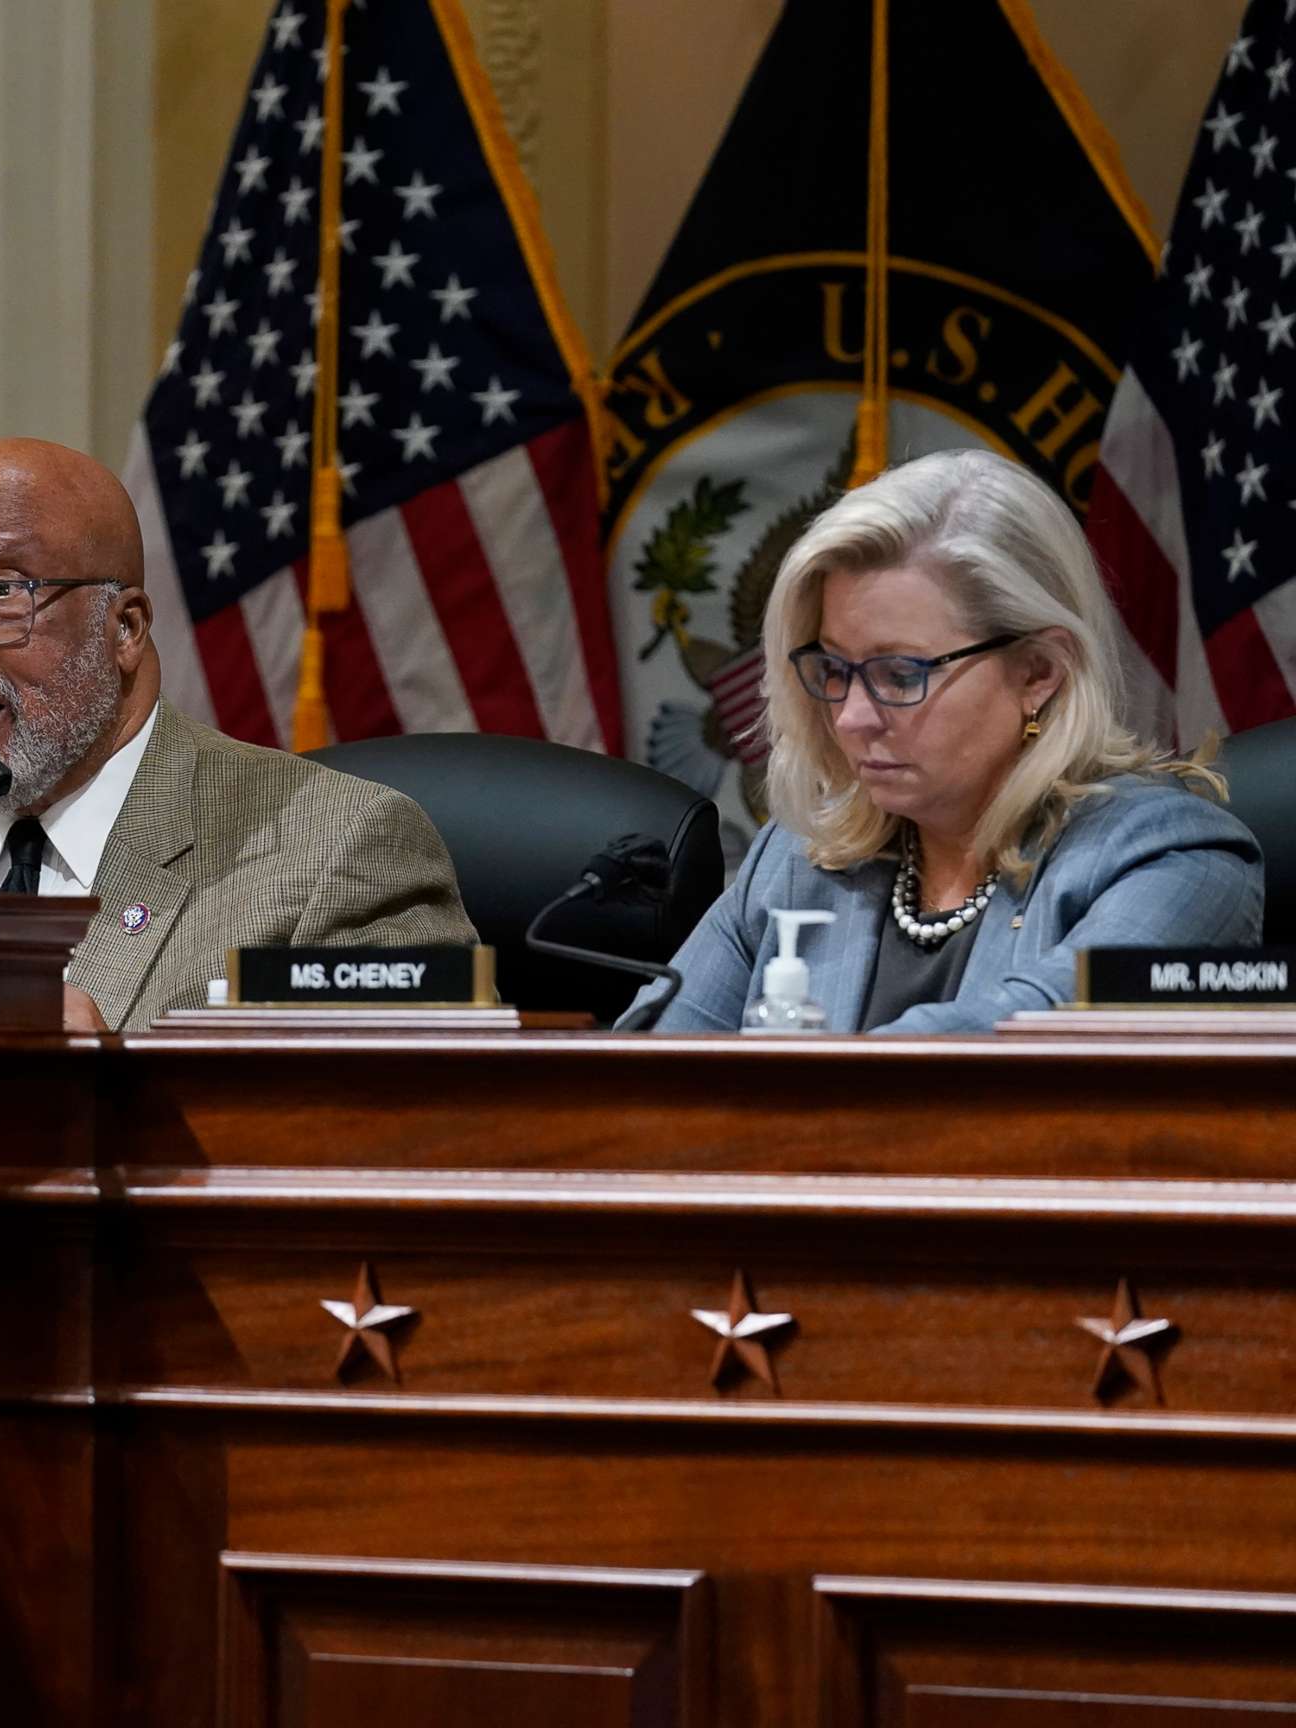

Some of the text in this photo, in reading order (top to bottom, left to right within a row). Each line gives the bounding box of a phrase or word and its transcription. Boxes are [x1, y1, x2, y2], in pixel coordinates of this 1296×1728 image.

[290, 962, 427, 989] MS. CHENEY
[1150, 961, 1289, 991] MR. RASKIN
